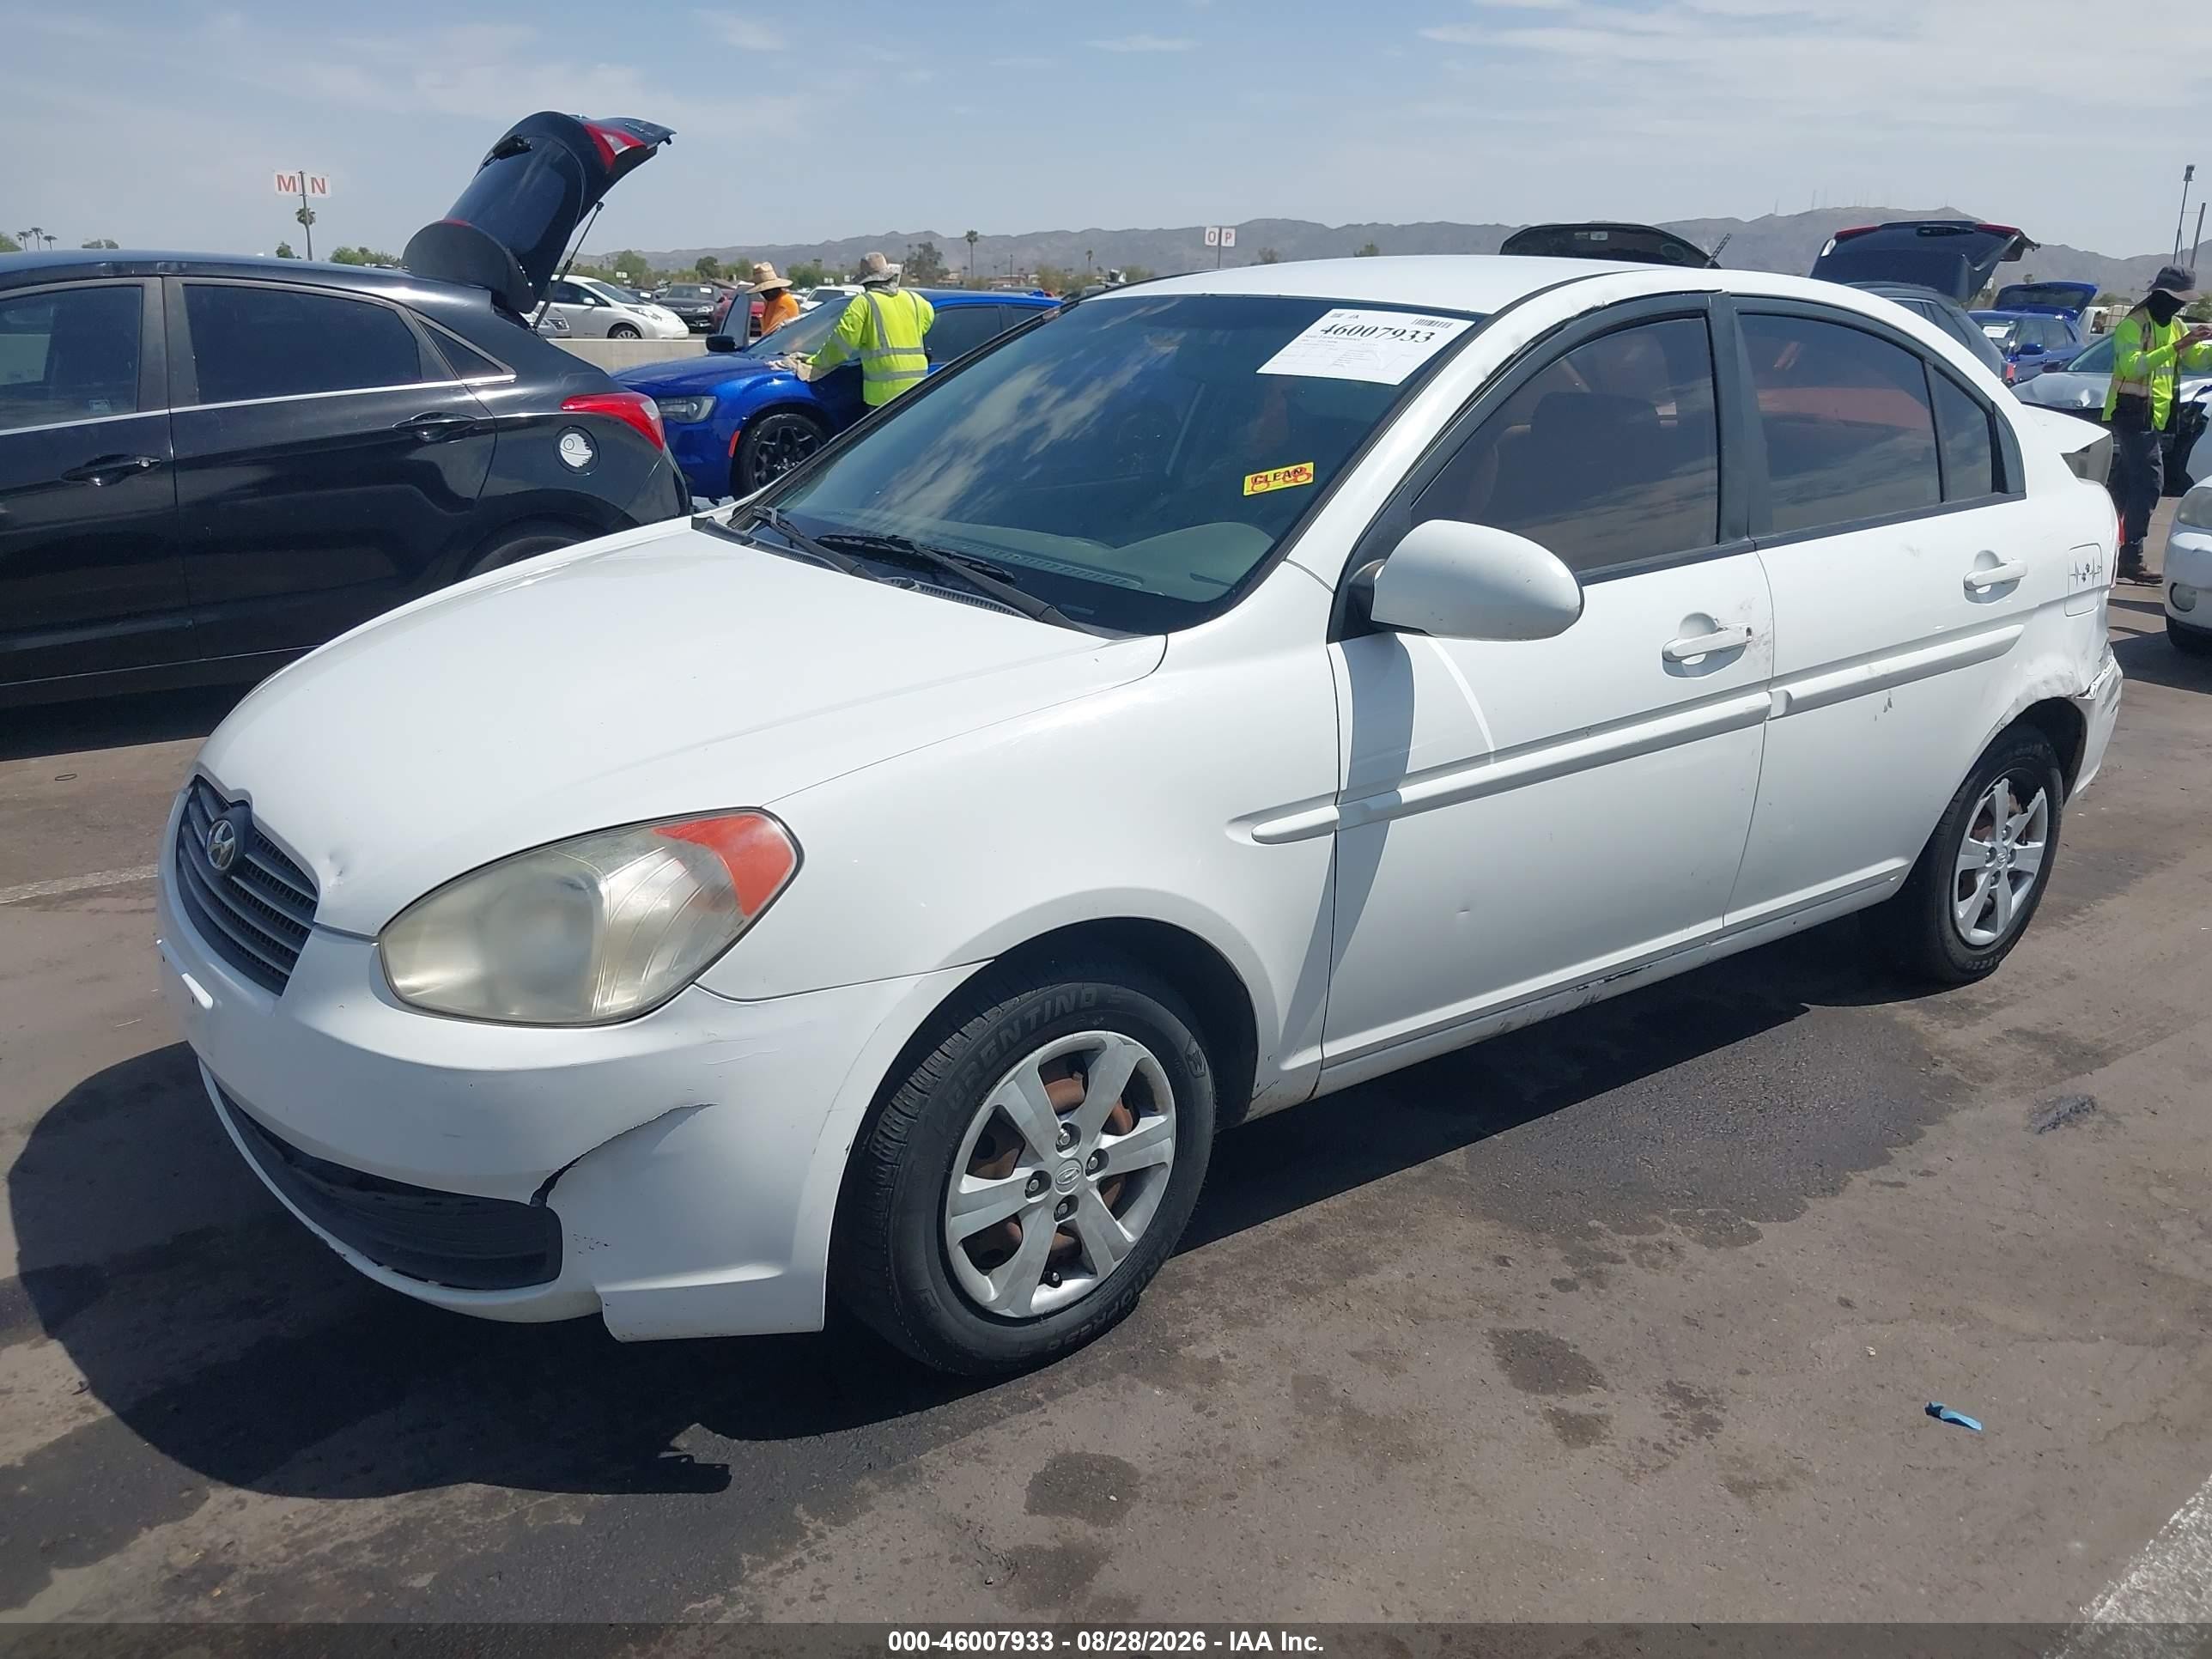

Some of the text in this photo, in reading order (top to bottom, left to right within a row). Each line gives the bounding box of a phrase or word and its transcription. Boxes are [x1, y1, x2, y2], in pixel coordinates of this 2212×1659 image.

[276, 174, 326, 194] M N
[1320, 323, 1436, 343] 46007933
